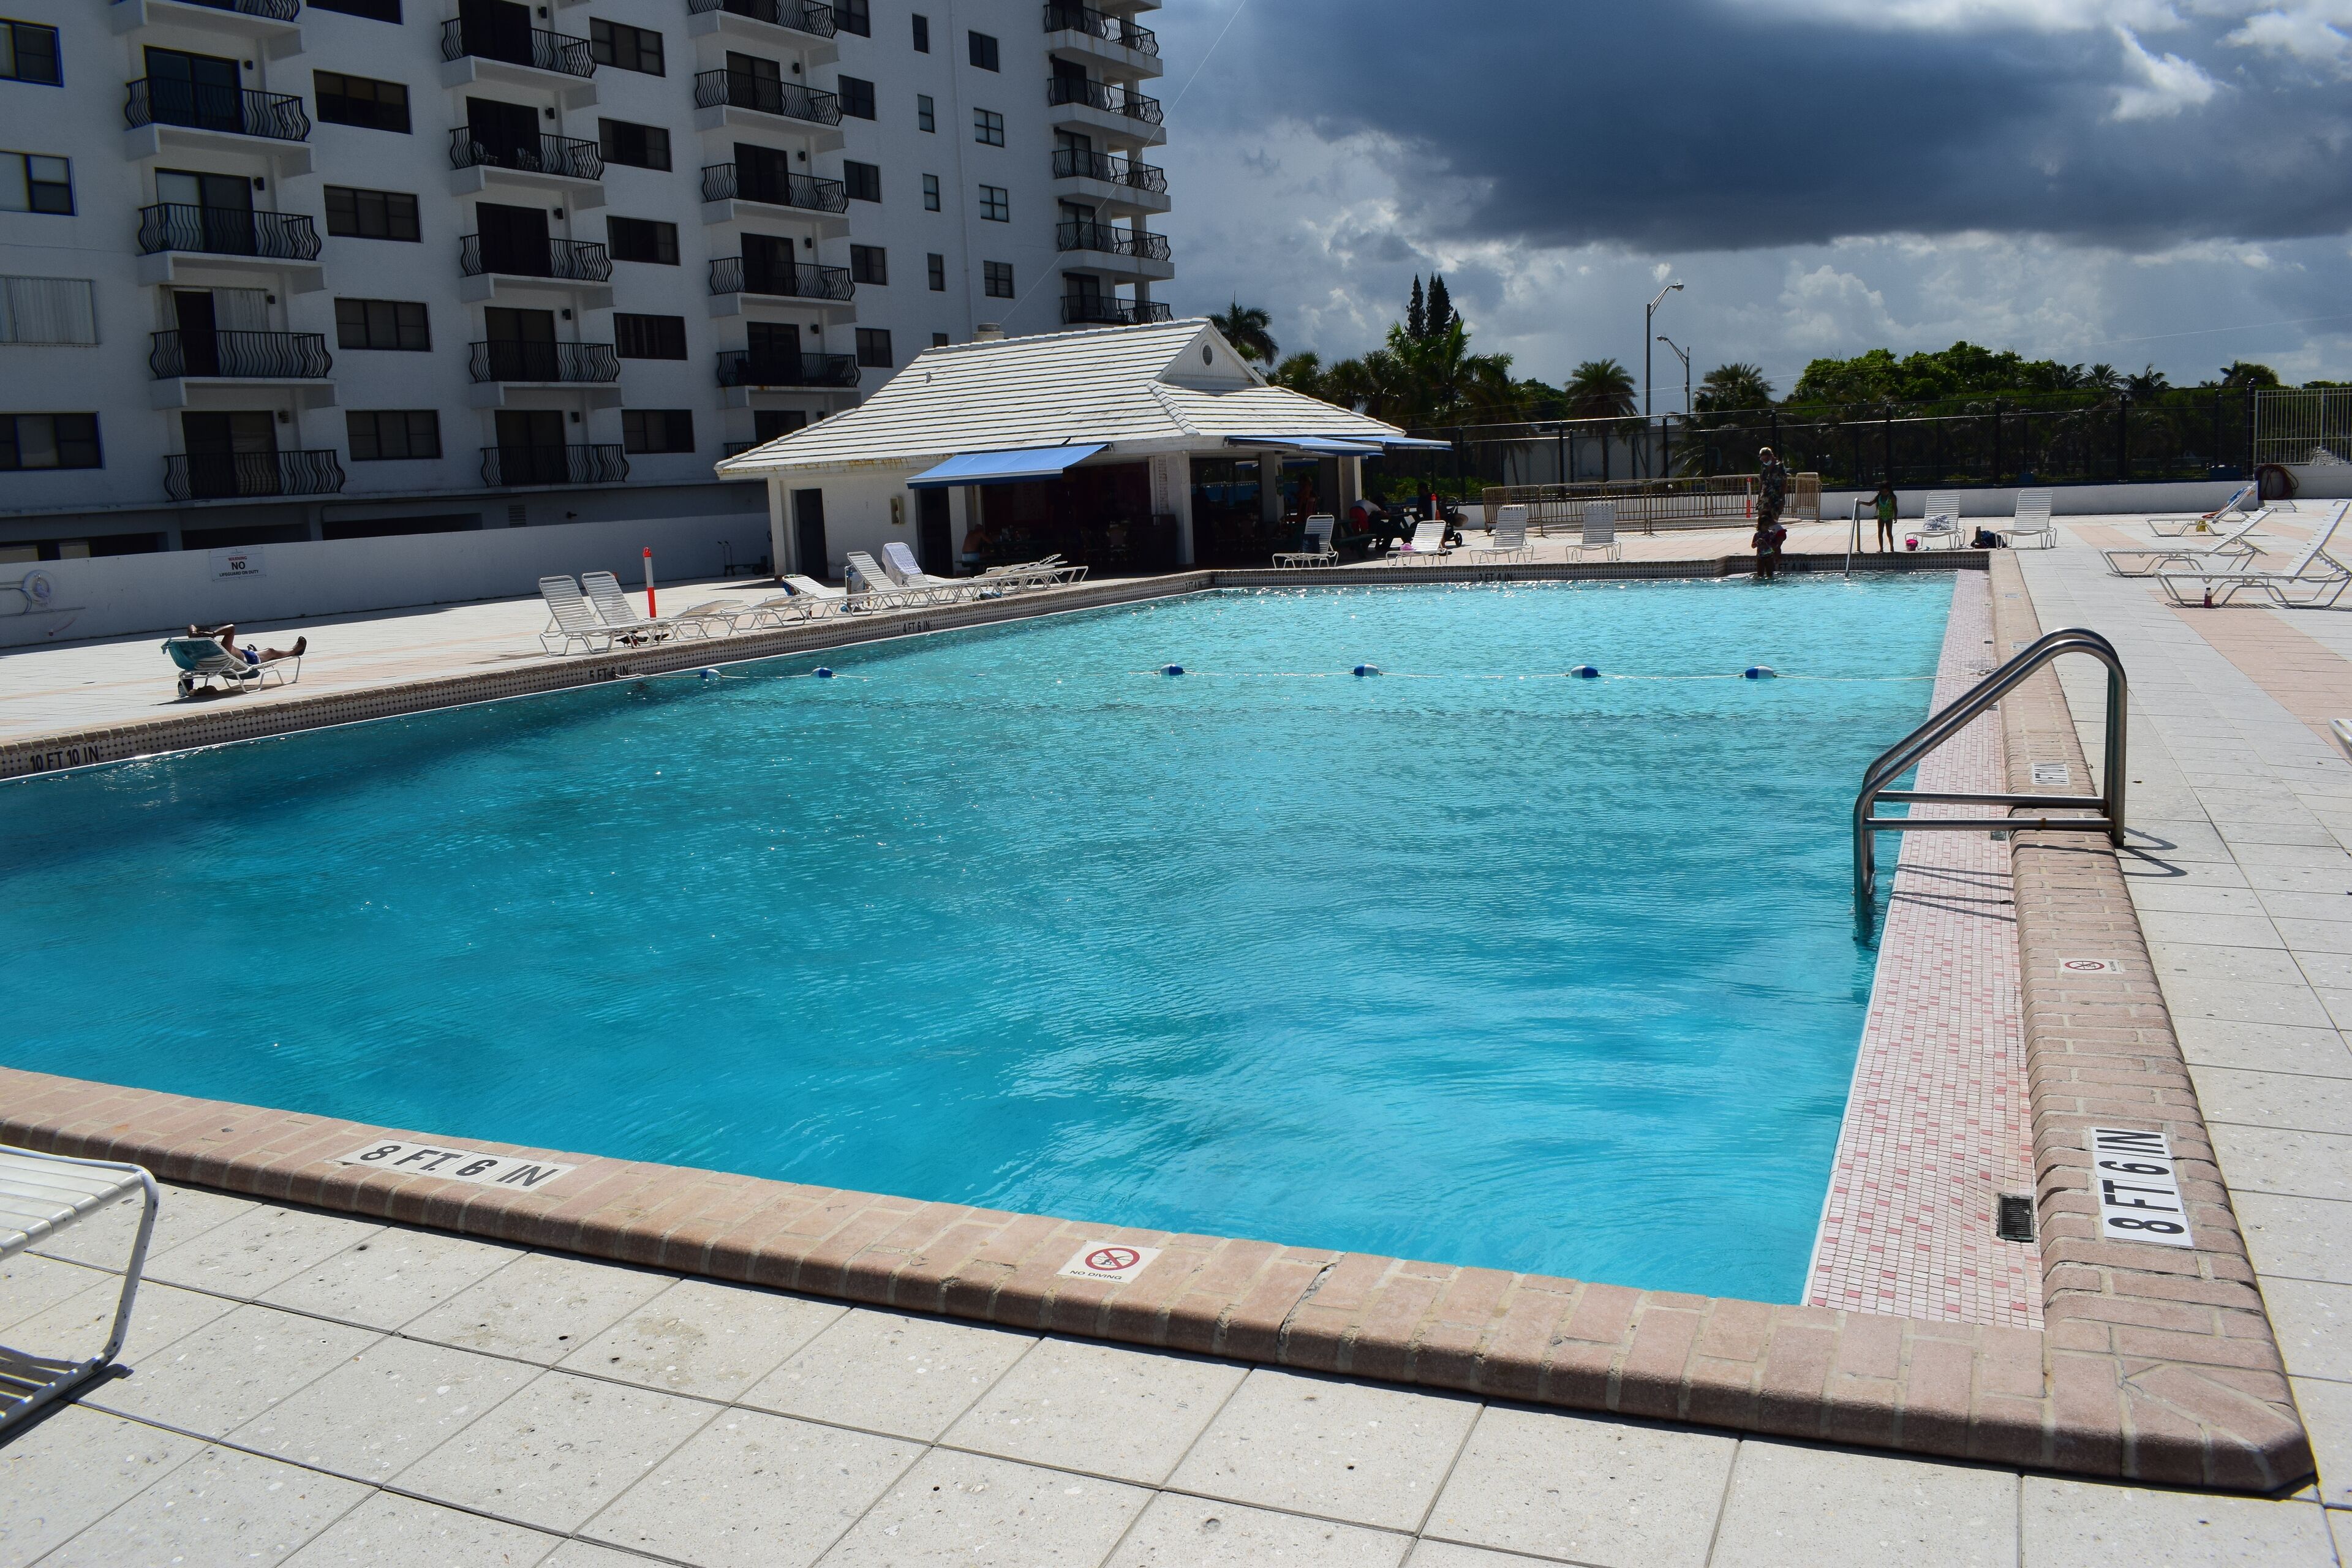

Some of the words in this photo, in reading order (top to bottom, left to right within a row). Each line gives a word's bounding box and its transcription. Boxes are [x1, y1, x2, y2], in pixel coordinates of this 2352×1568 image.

[232, 561, 245, 570] NO
[1485, 573, 1494, 582] FT
[903, 623, 907, 633] 4
[908, 622, 915, 632] FT
[918, 622, 921, 631] 6
[924, 620, 930, 630] IN
[589, 670, 594, 680] 5
[598, 668, 607, 681] FT
[620, 665, 628, 676] IN
[30, 754, 43, 772] 10
[47, 751, 63, 769] FT
[67, 748, 80, 766] 10
[83, 745, 99, 763] IN
[2095, 1129, 2166, 1155] IN
[360, 1145, 401, 1161] 8
[456, 1159, 499, 1177] 6
[495, 1165, 559, 1187] IN
[2098, 1160, 2169, 1175] 6
[2102, 1179, 2179, 1213] FT
[2108, 1217, 2185, 1234] 8
